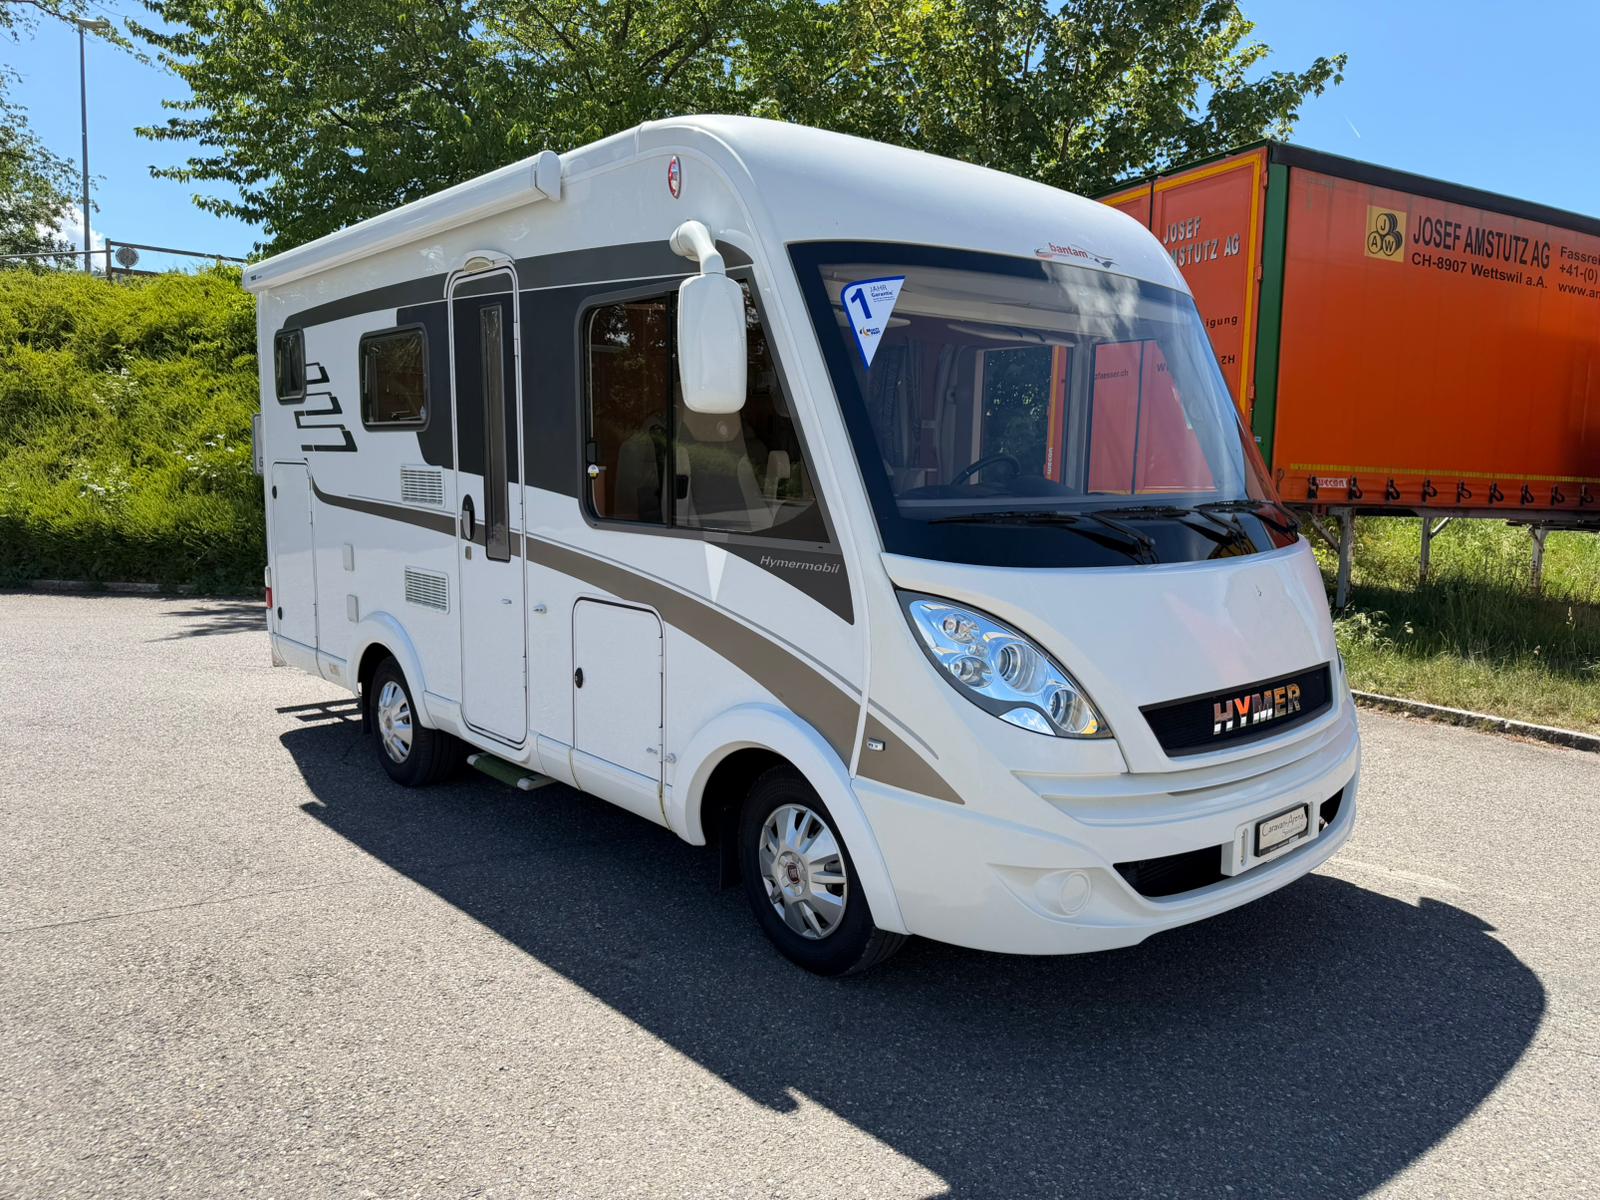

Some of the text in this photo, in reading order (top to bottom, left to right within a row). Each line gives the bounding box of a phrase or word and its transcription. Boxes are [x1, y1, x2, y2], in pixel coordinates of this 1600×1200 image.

[1163, 216, 1201, 245] JOSEF
[1224, 232, 1240, 256] AG
[1413, 216, 1550, 269] JOSEF AMSTUTZ AG
[1048, 242, 1088, 258] bantam
[1411, 252, 1548, 289] CH-8907 Wettswil a.A.
[1559, 264, 1598, 285] +41-(0)
[850, 288, 872, 319] 1
[760, 555, 840, 573] Hymermobil
[1213, 683, 1301, 735] HYMER
